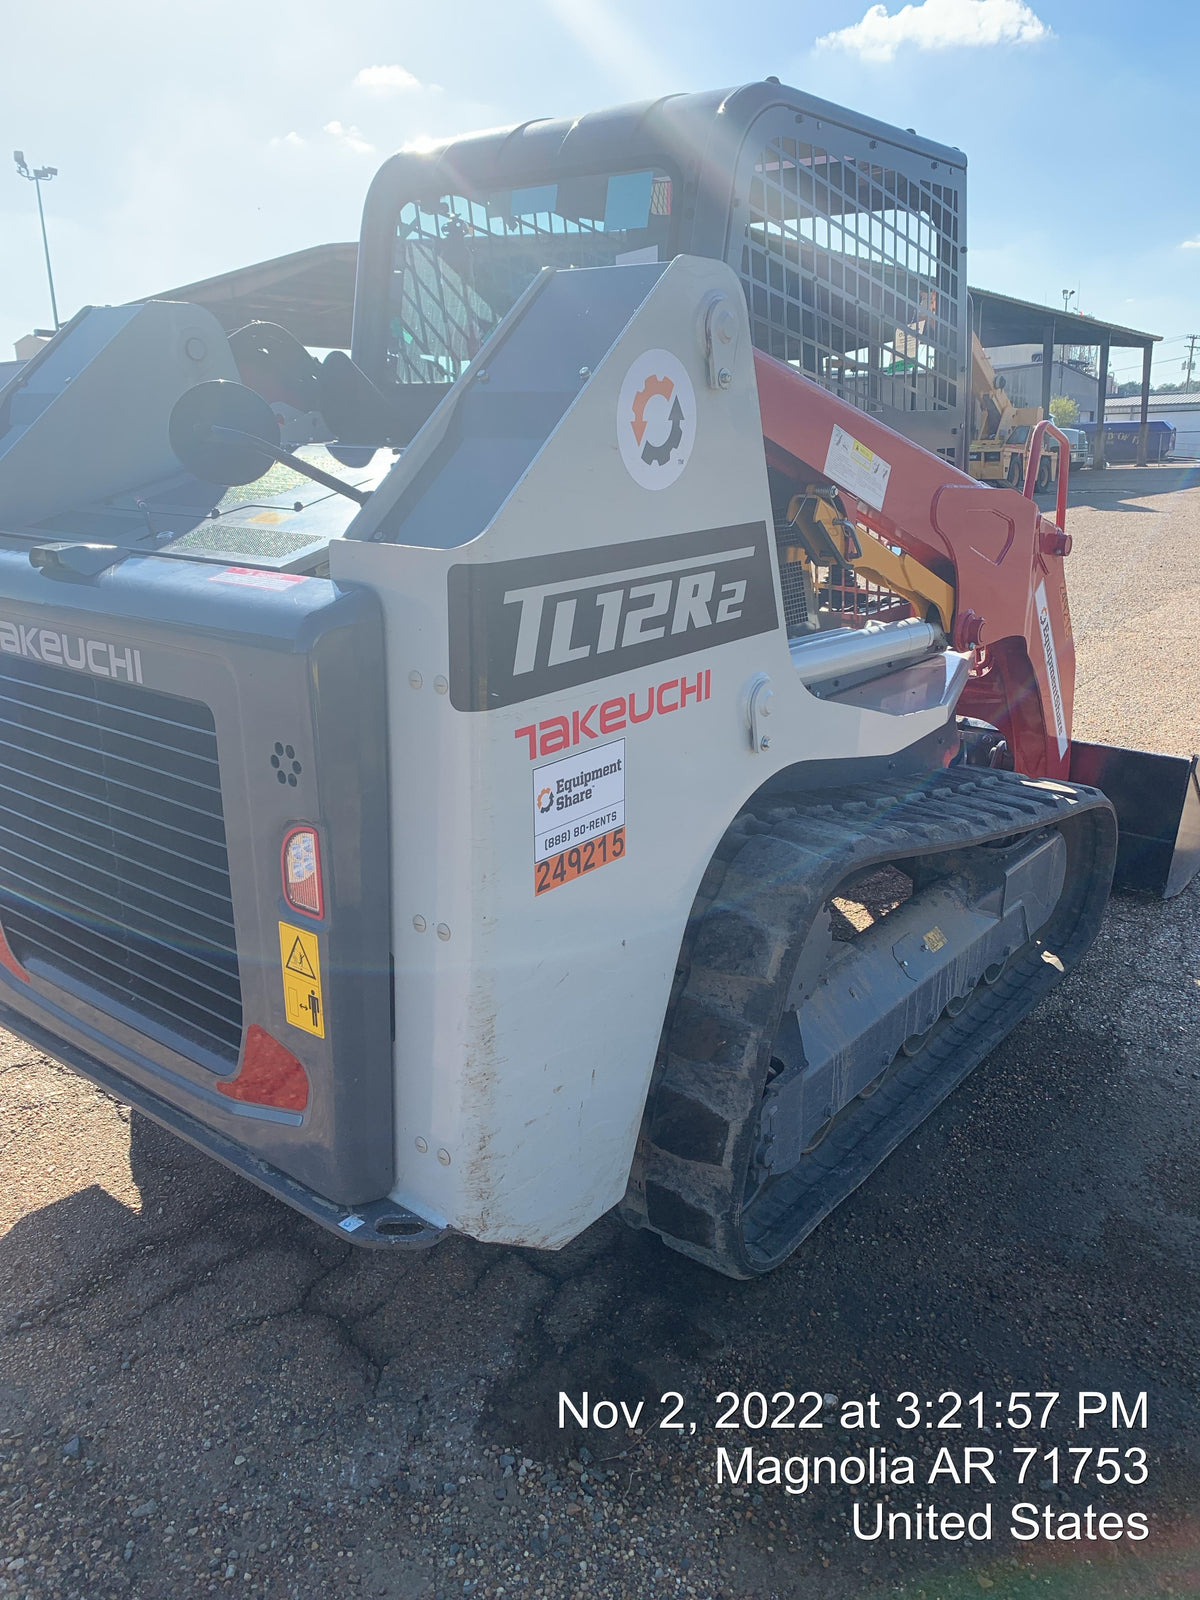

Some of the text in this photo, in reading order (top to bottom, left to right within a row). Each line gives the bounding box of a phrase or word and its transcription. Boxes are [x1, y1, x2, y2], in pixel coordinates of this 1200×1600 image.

[503, 546, 755, 676] TL12R2
[0, 620, 143, 684] AKEUCHI
[514, 669, 711, 760] TAKEUCHI
[555, 758, 622, 794] Equipment
[555, 788, 593, 811] Share
[537, 828, 624, 893] 249215
[544, 811, 617, 851] (888) 80-RENTS
